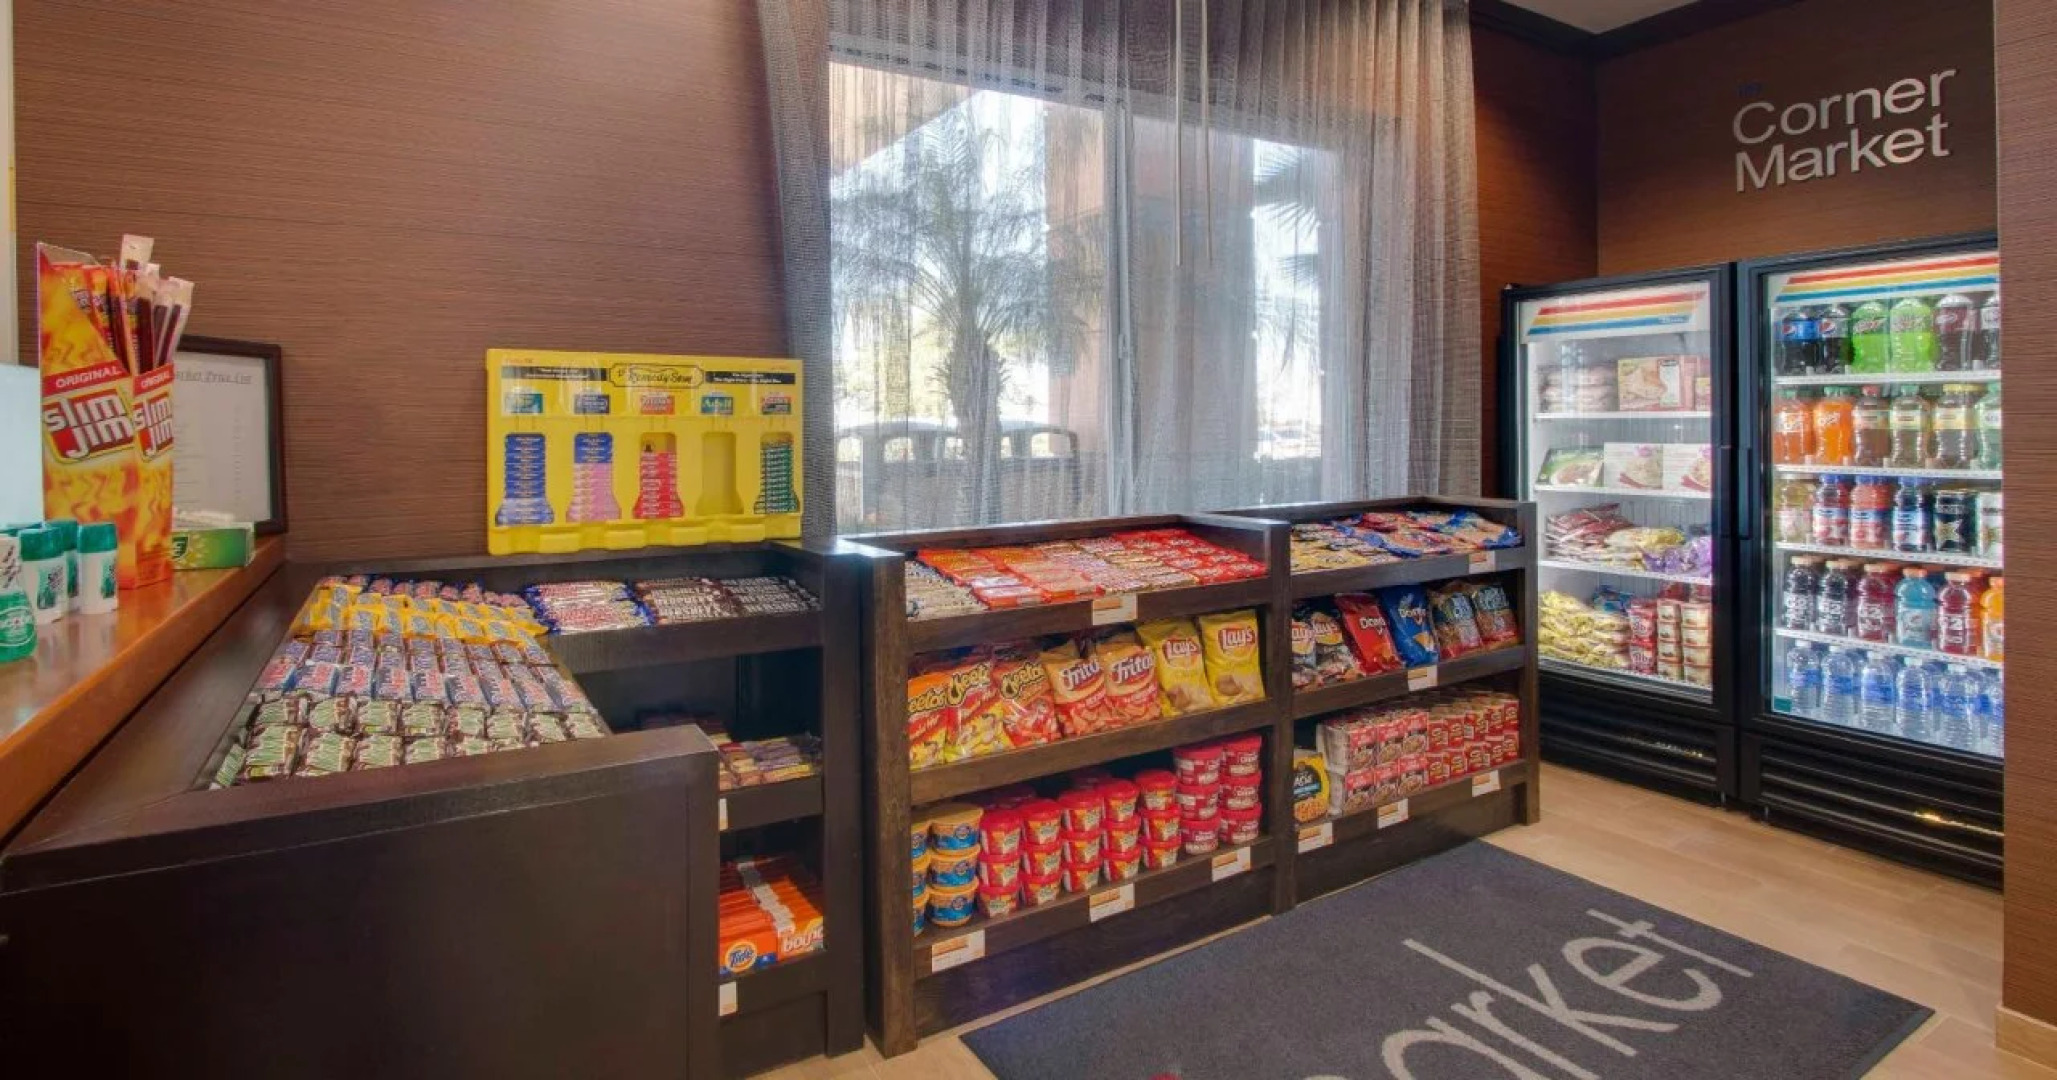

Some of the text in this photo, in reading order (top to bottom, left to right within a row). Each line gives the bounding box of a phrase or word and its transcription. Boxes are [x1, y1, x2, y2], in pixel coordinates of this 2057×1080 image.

[1732, 68, 1957, 145] Corner
[1735, 113, 1951, 193] Market
[55, 364, 121, 389] ORIGINAL
[1112, 651, 1157, 684] Frito
